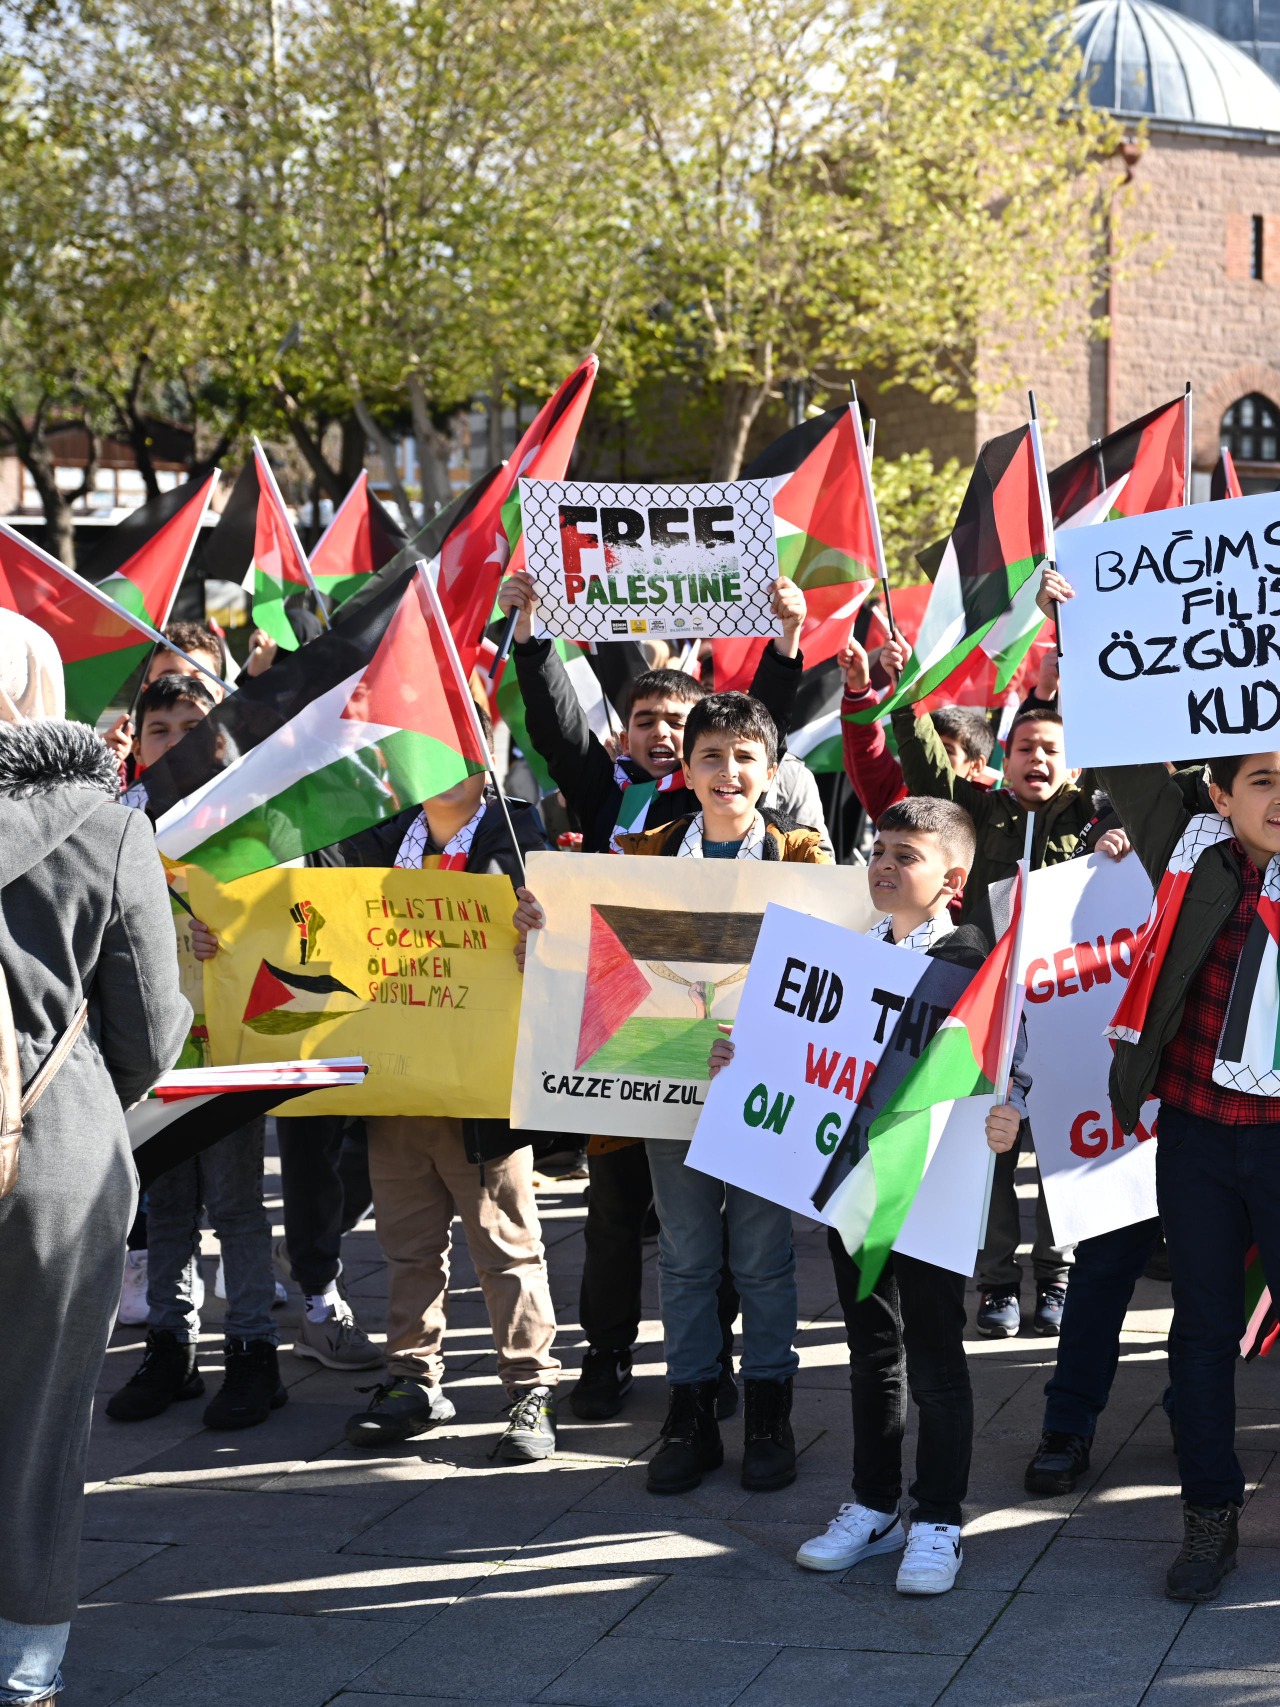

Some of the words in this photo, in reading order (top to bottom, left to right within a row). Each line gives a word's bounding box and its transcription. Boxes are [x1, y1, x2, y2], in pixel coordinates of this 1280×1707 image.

[558, 504, 739, 574] FREE
[564, 572, 742, 605] PALESTINE
[365, 895, 491, 923] FİLİSTİN'İN
[367, 927, 487, 951] ÇOCUKLARI
[367, 954, 451, 978] ÖLÜRKEN
[1025, 922, 1147, 1004] GENO
[368, 981, 469, 1009] SUSULMAZ
[774, 956, 844, 1024] END
[804, 1042, 875, 1110] WAR
[743, 1083, 796, 1136] ON
[934, 1525, 949, 1533] NIKE
